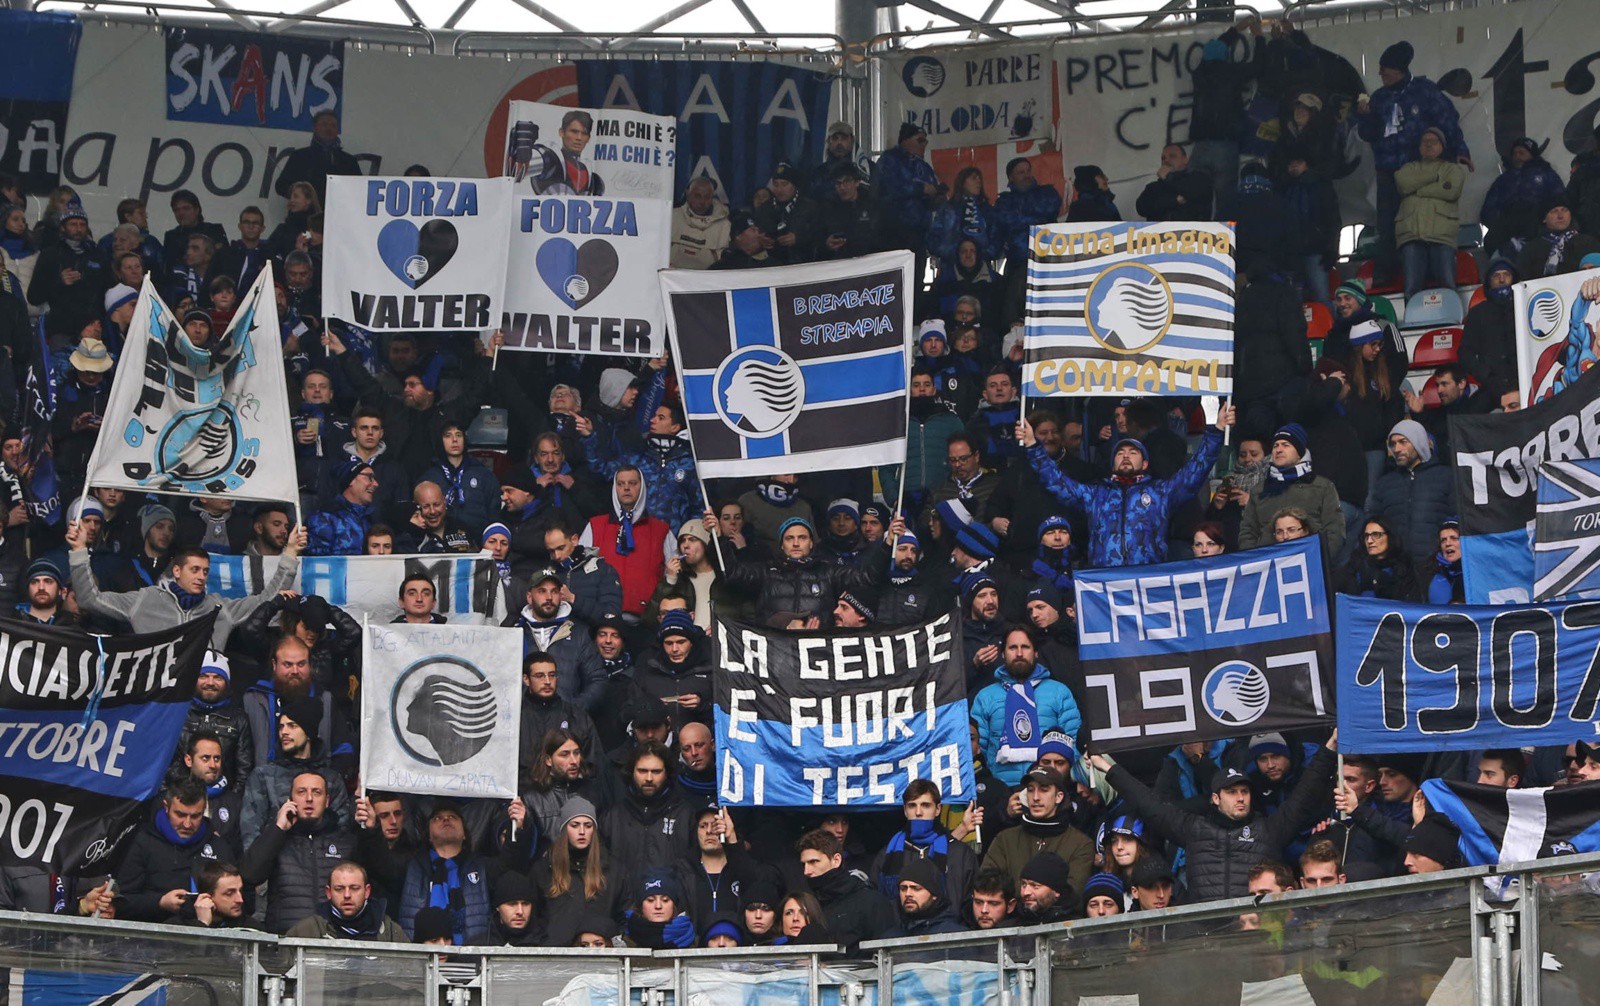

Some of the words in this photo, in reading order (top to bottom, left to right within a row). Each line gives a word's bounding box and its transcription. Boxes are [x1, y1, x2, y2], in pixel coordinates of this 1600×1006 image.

[170, 43, 341, 124] SKANS
[965, 53, 1041, 88] PARRE
[679, 74, 731, 124] A
[761, 78, 811, 131] A
[596, 120, 620, 137] MA
[624, 121, 651, 141] CHI
[655, 123, 662, 143] È
[594, 144, 618, 161] MA
[622, 145, 650, 165] CHI
[653, 146, 662, 167] È
[366, 180, 478, 217] FORZA
[520, 199, 639, 236] FORZA
[1033, 228, 1115, 257] Corna
[1126, 226, 1230, 256] Imagna
[350, 290, 491, 328] VALTER
[793, 283, 896, 316] BREMBATE
[502, 312, 652, 354] VALTER
[800, 315, 894, 345] STREMPIA
[1033, 358, 1219, 393] COMPATTI
[1074, 552, 1314, 646] CASAZZA
[717, 620, 769, 679] LA
[790, 681, 937, 748] FUORI
[720, 748, 765, 806] DI
[803, 743, 962, 806] TESTA
